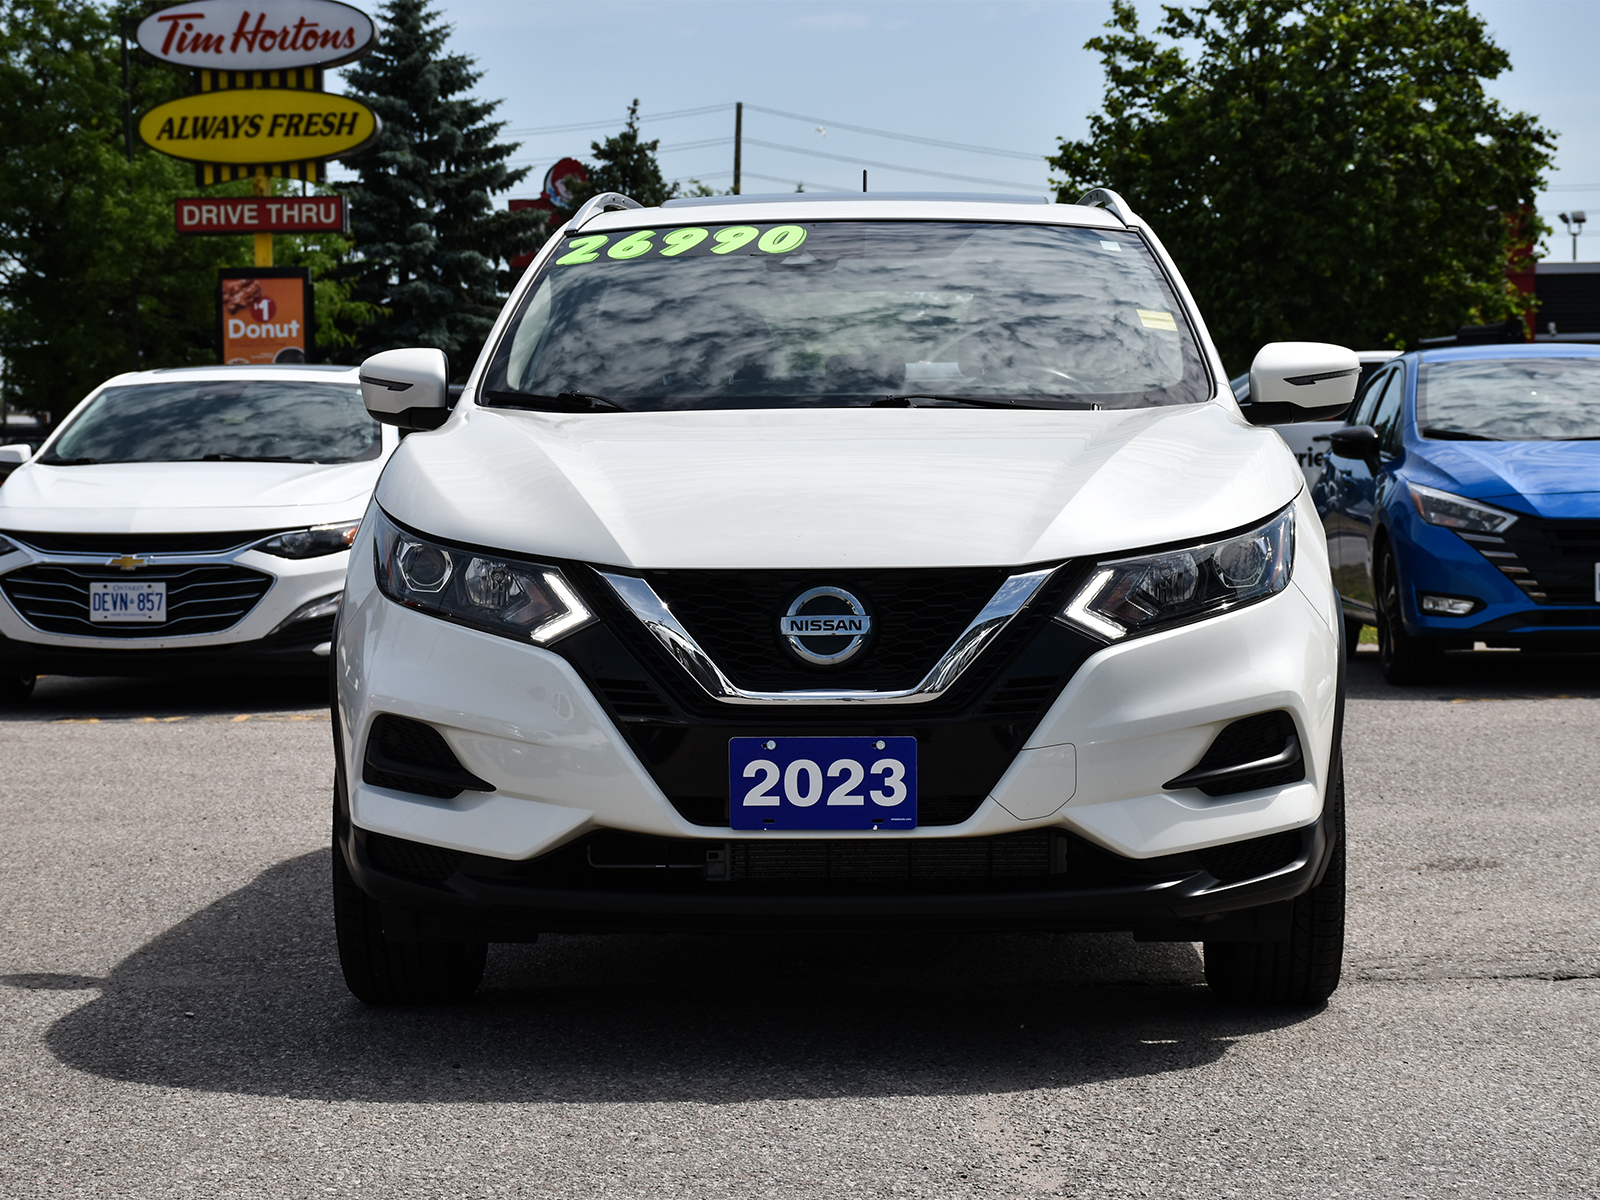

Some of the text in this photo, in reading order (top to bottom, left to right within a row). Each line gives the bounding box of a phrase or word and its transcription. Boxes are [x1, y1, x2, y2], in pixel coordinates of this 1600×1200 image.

[157, 11, 355, 56] Tim Hortons
[156, 112, 359, 141] ALWAYS FRESH
[182, 203, 336, 226] DRIVE THRU
[555, 224, 808, 266] 26990
[228, 319, 300, 339] Donut
[93, 592, 163, 612] DEVN 857
[790, 619, 863, 632] NISSAN
[742, 758, 908, 808] 2023
